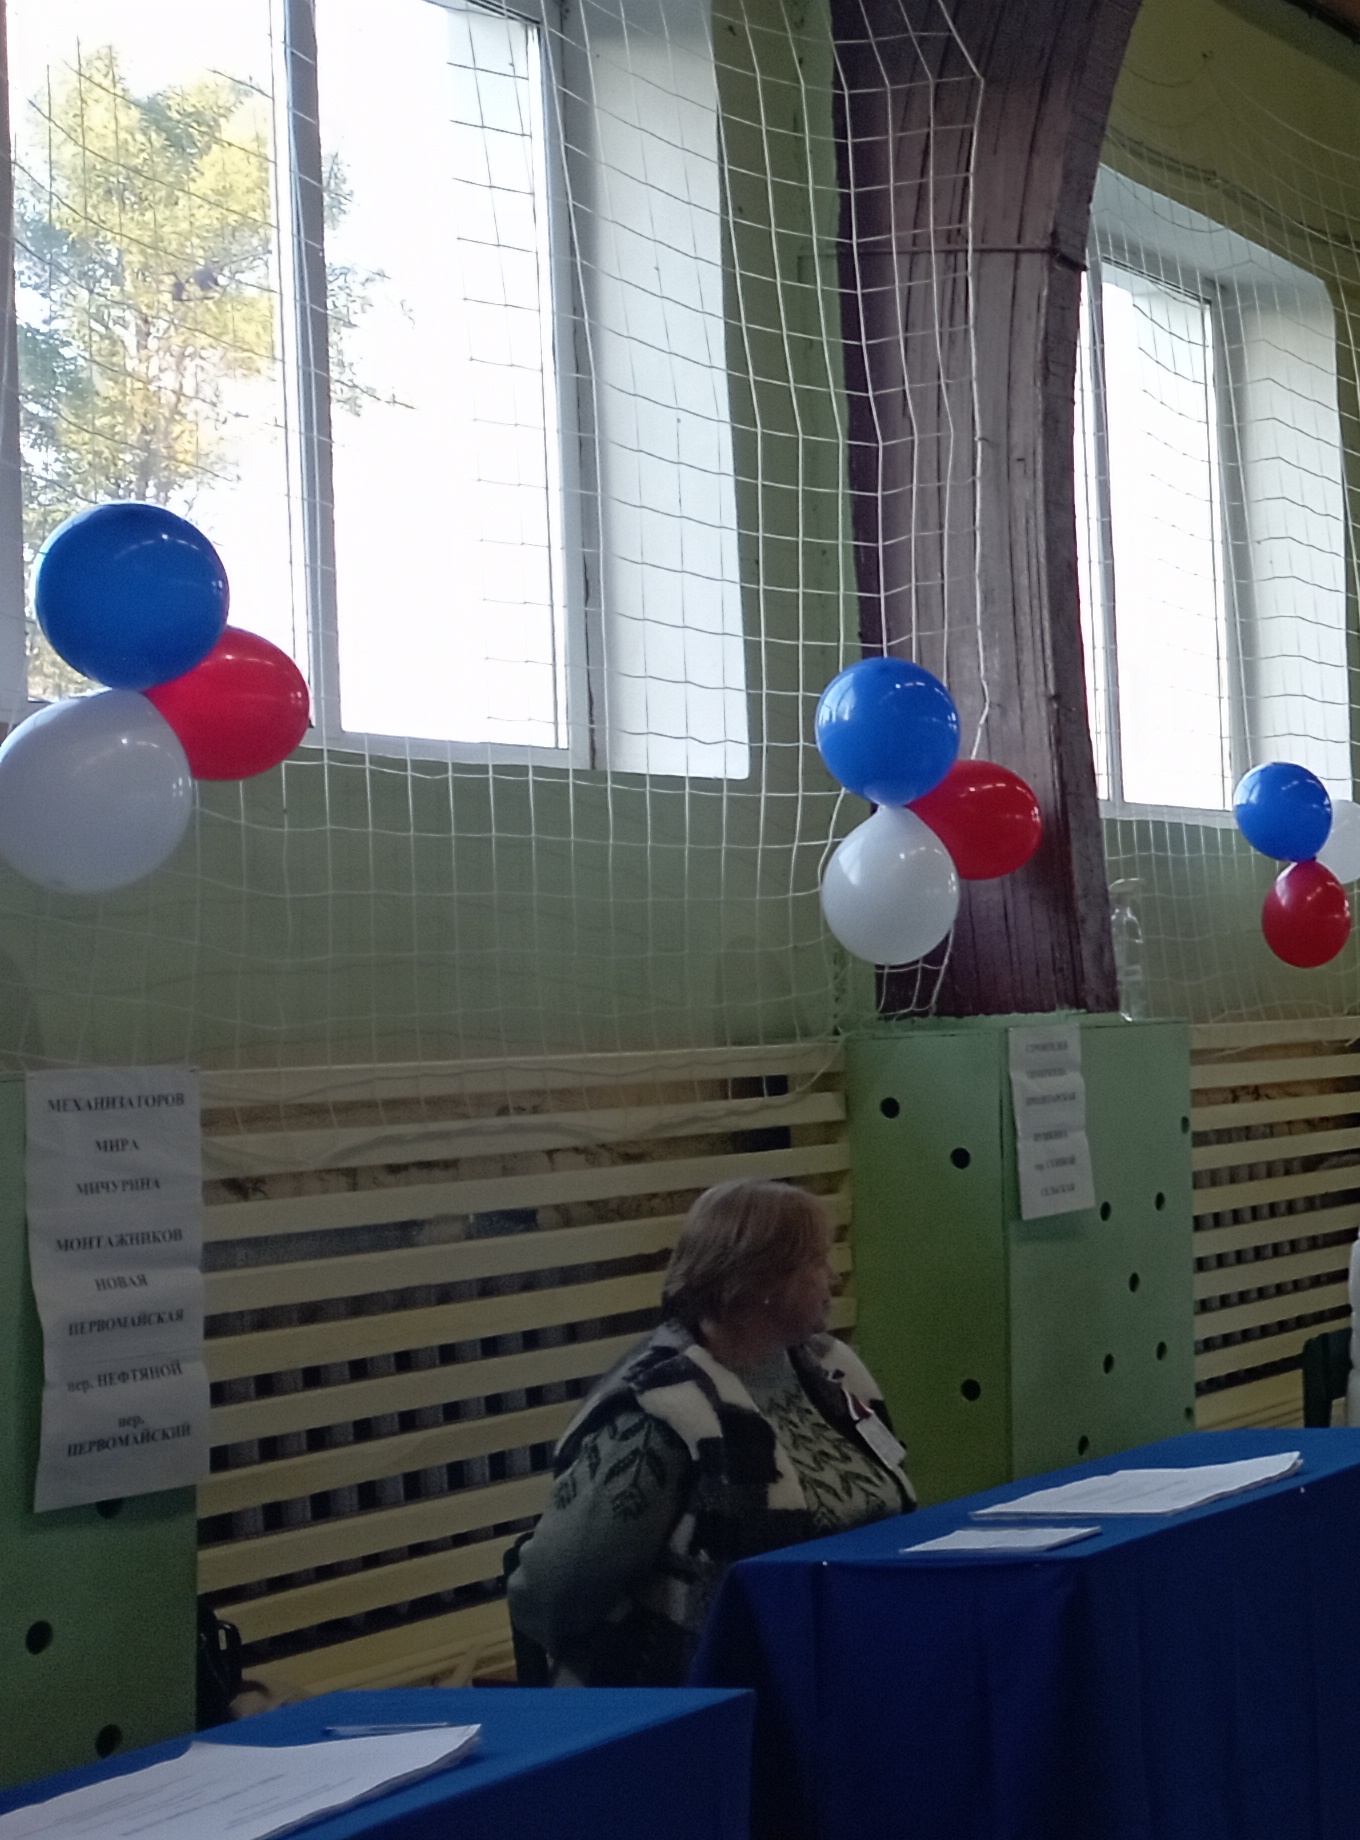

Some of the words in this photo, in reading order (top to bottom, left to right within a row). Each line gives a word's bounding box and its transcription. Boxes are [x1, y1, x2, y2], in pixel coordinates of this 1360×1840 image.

[48, 1092, 185, 1113] МЕХАНИЗАТОРОВ
[95, 1138, 139, 1153] МИРА
[77, 1177, 160, 1196] МИЧУРИНА
[56, 1229, 183, 1252] МОНТАЖНИКОВ
[95, 1273, 148, 1291] НОВАЯ
[68, 1309, 185, 1336] ПЕРВОМАЙСКАЯ
[67, 1379, 94, 1393] пер.
[98, 1360, 183, 1387] НЕФТЯНОЙ
[118, 1415, 144, 1428] пер.
[67, 1422, 191, 1457] ПЕРВОМАЙСКИЙ
